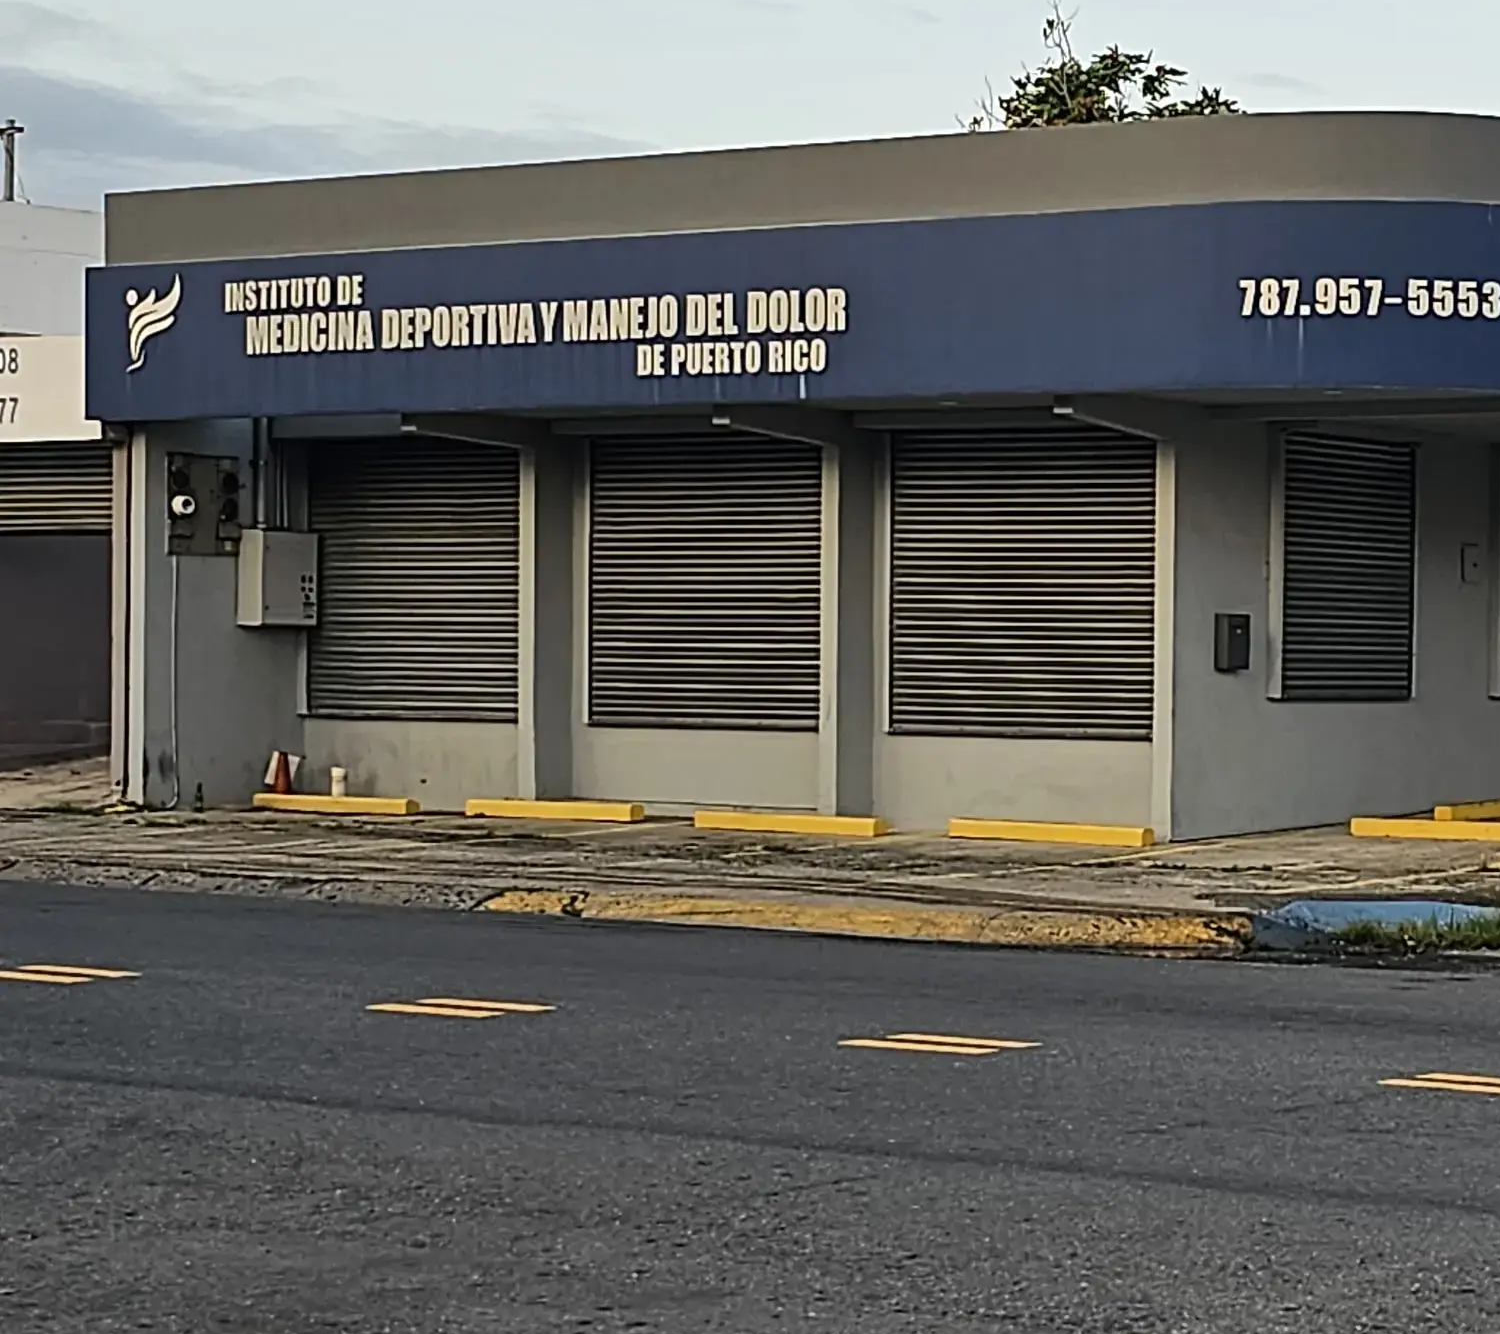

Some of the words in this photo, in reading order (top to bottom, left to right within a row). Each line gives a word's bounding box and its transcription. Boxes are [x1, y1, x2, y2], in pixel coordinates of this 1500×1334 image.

[224, 275, 331, 312] INSTITUTO
[336, 274, 364, 307] DE
[246, 310, 374, 355] MEDICINA
[381, 303, 536, 350] DEPORTIVA
[540, 301, 558, 342] Y
[563, 294, 678, 342] MANEJO
[685, 292, 739, 336] DEL
[747, 287, 847, 334] DOLOR
[636, 343, 665, 376] DE
[671, 340, 761, 375] PUERTO
[768, 338, 827, 373] RICO
